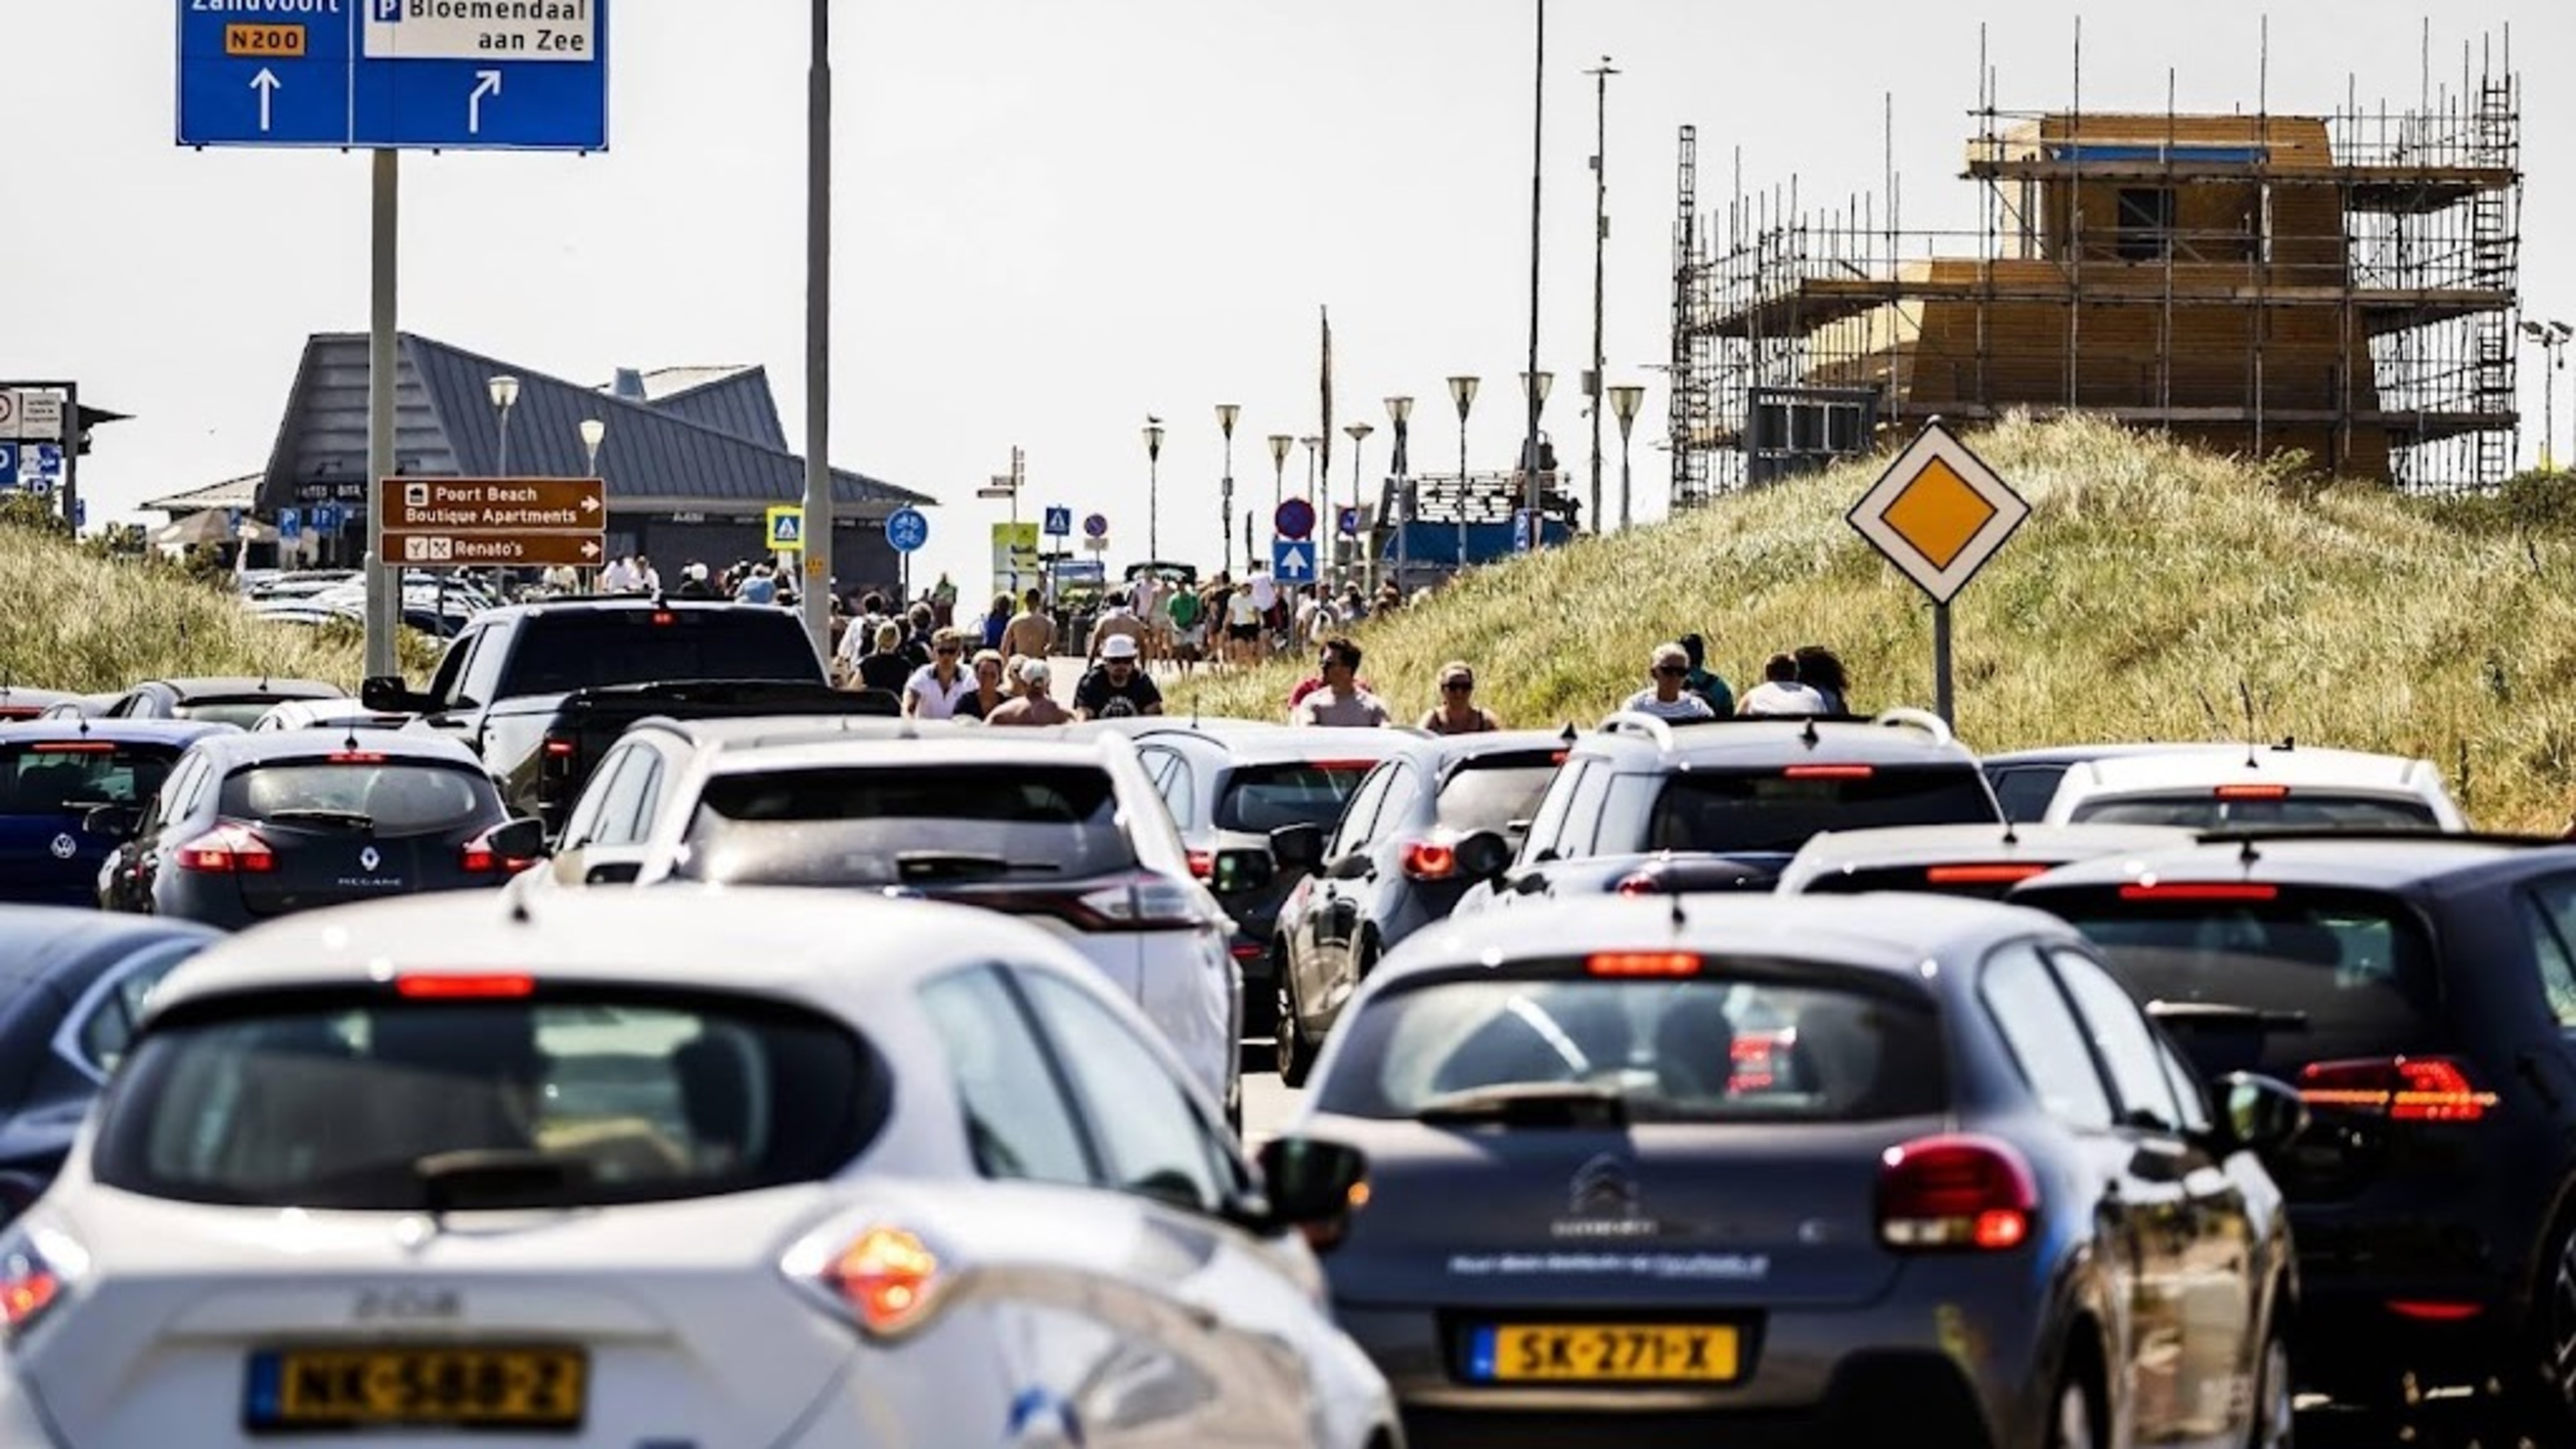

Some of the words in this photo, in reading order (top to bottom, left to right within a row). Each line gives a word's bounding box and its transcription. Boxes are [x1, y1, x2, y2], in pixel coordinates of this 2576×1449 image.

[409, 0, 584, 19] Bloemendaal
[231, 31, 299, 48] N200
[478, 33, 525, 50] aan
[537, 30, 584, 51] Zee
[436, 486, 482, 502] Poort
[487, 486, 537, 502] Beach
[405, 507, 477, 524] Boutique
[482, 507, 577, 525] Apartments
[455, 540, 524, 556] Renato's
[1520, 1331, 1710, 1371] SK-271-X
